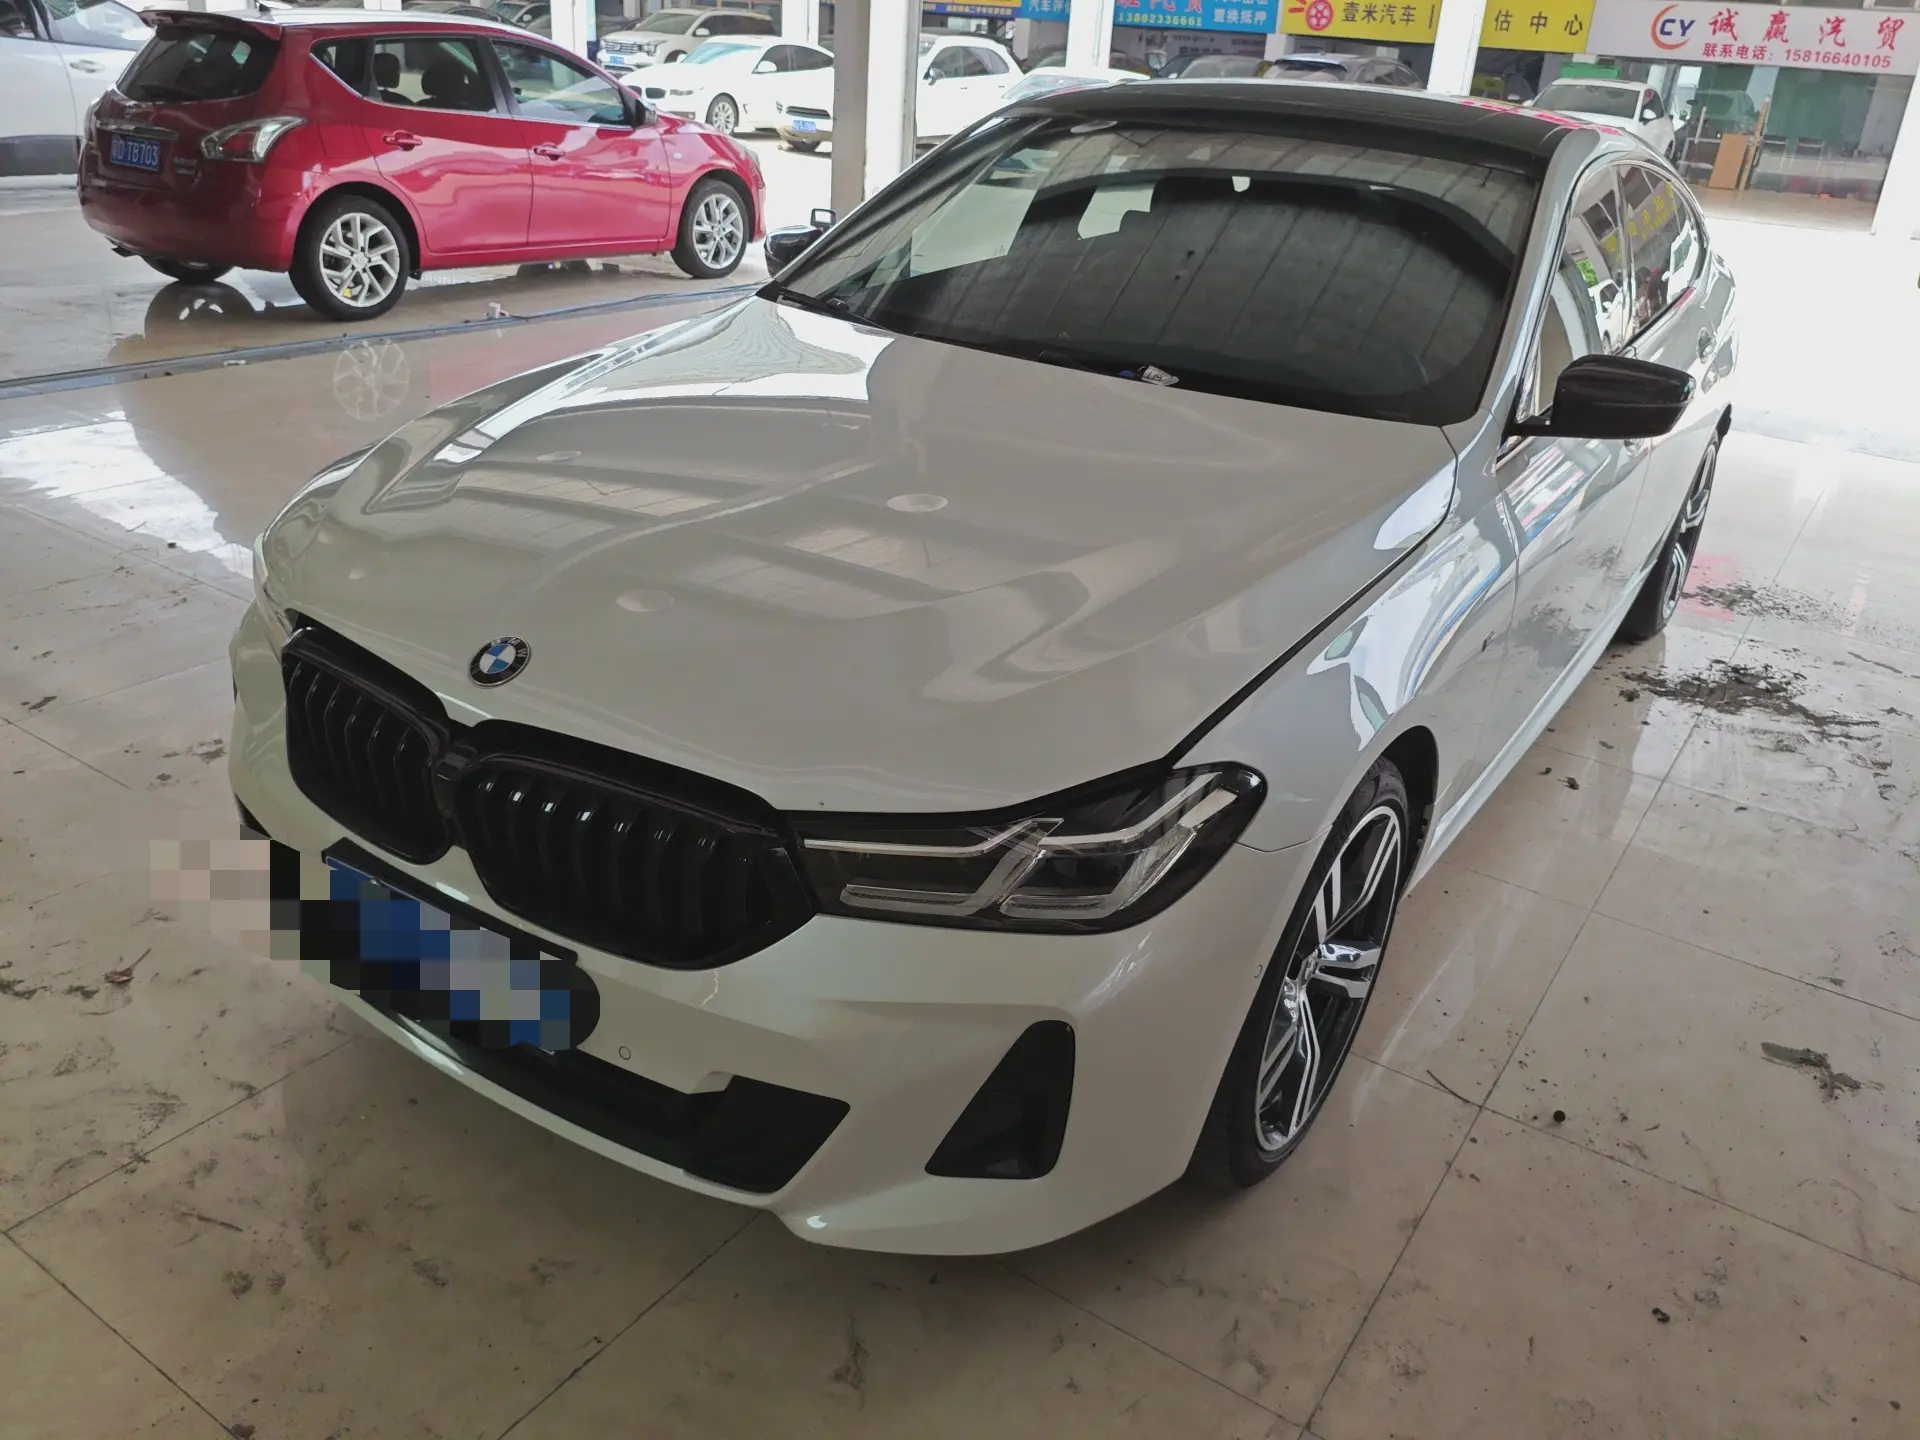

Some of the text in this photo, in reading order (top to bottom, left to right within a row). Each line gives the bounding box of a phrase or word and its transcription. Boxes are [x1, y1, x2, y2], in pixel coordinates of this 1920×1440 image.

[1342, 2, 1583, 36] 壹米汽车 估中心
[1660, 18, 1695, 37] CY
[1709, 8, 1905, 50] 诚赢汽贸
[1785, 49, 1891, 68] 15816640105
